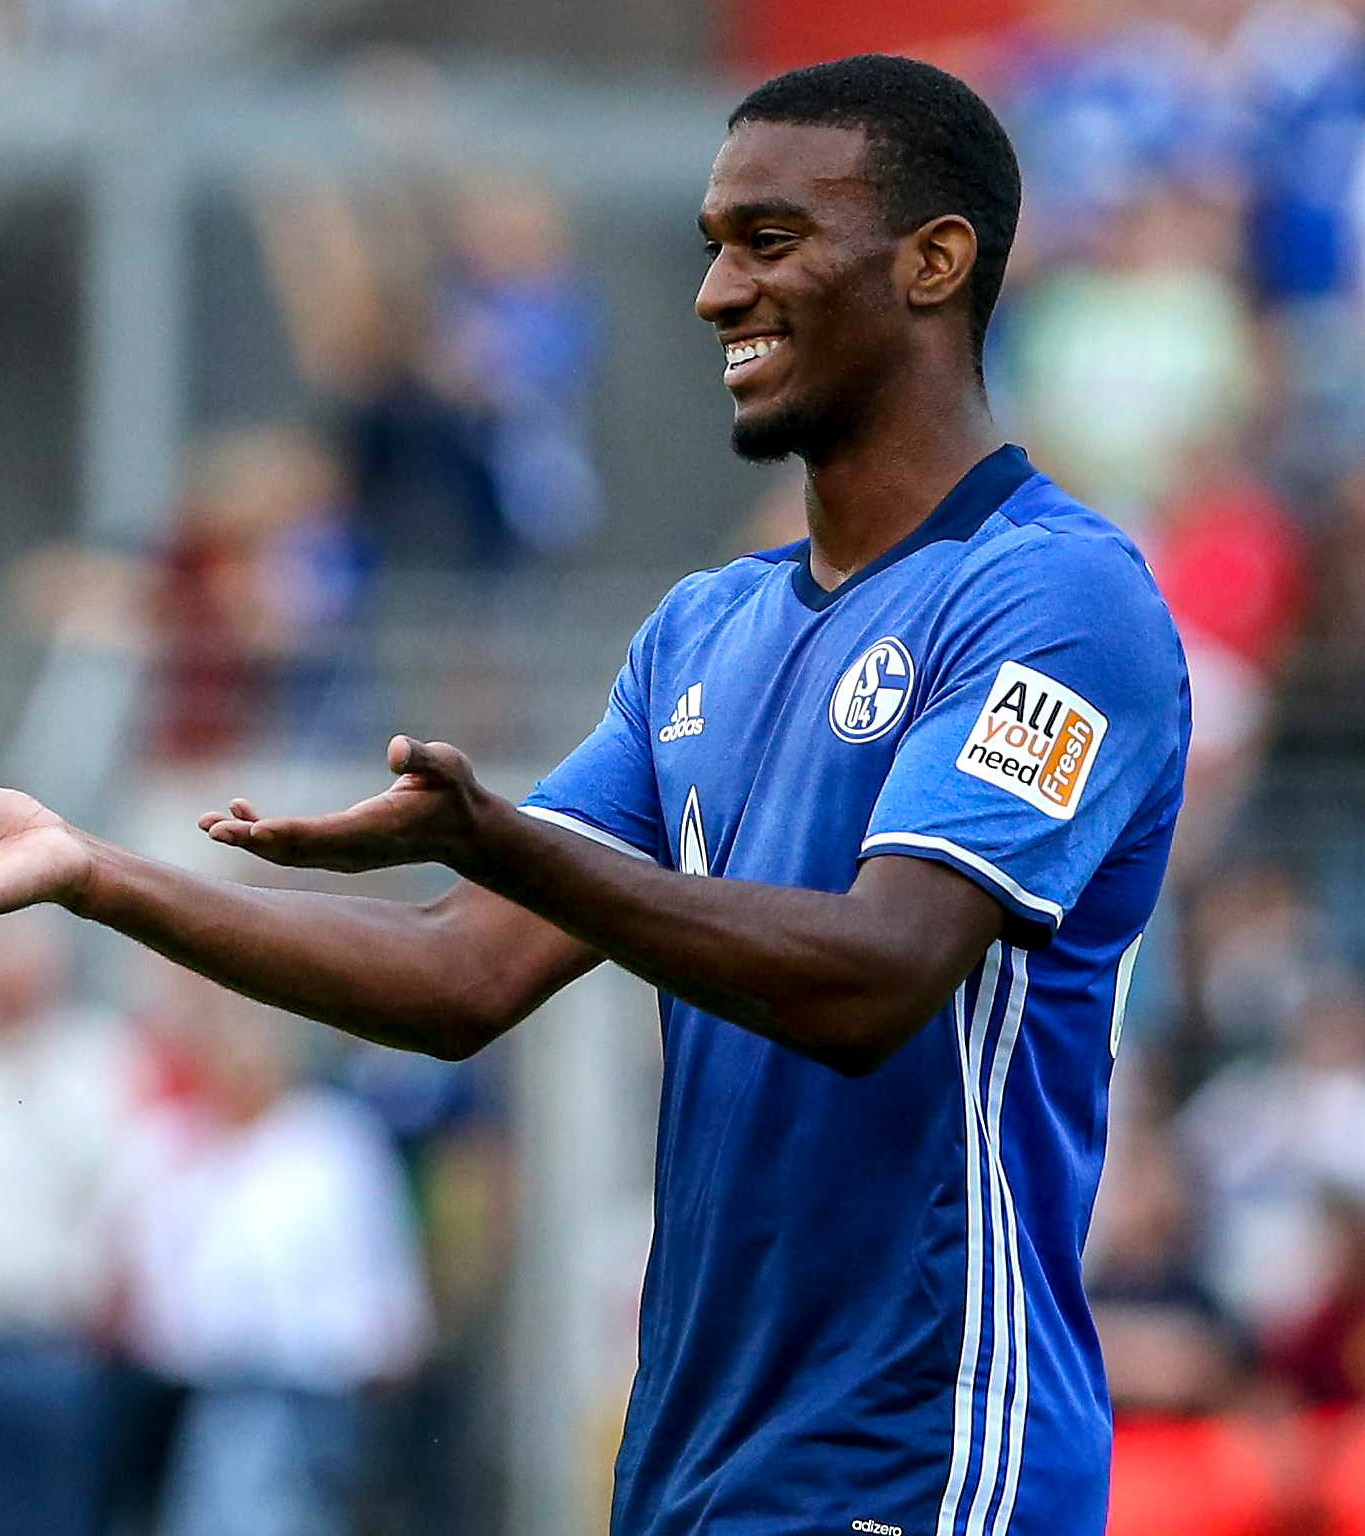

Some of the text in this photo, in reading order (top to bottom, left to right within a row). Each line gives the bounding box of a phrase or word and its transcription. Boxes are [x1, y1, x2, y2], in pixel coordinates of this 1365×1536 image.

[659, 716, 705, 742] adidas
[991, 681, 1063, 739] All
[982, 715, 1050, 761] you
[967, 743, 1040, 787] need
[1041, 720, 1090, 802] Fresh
[852, 1519, 902, 1536] adizero
